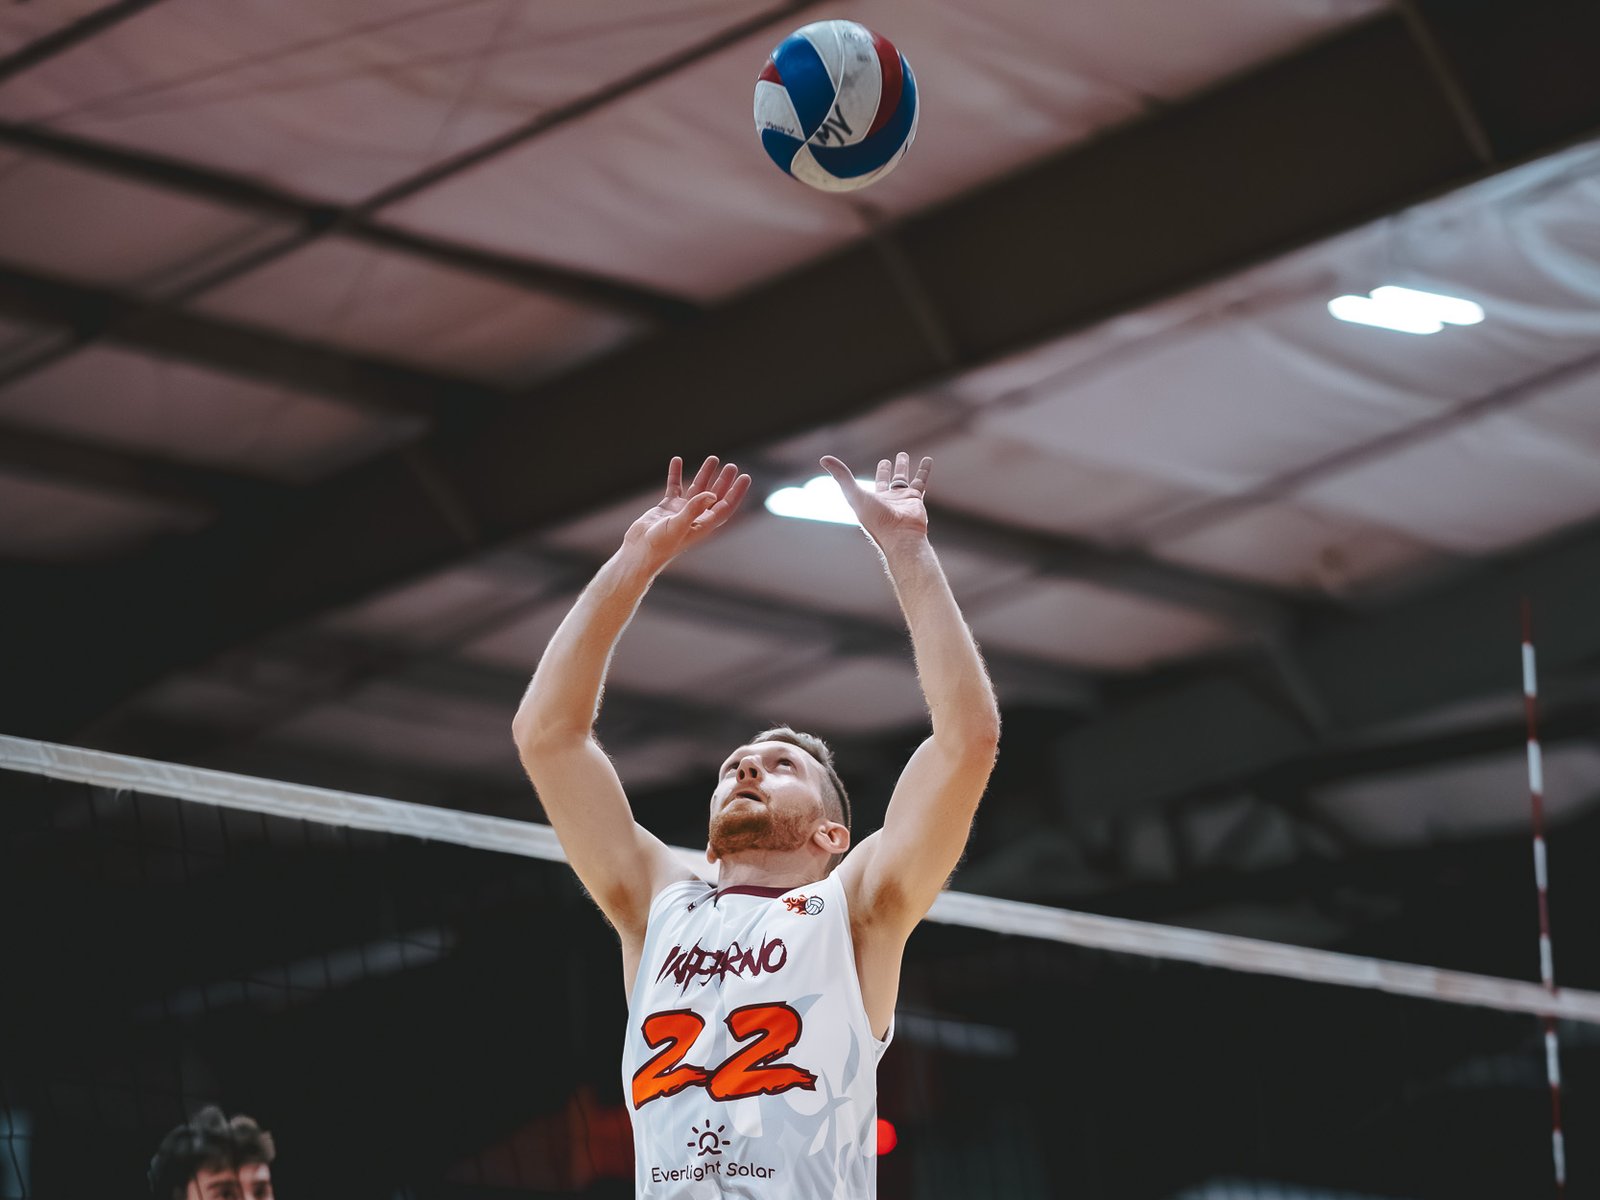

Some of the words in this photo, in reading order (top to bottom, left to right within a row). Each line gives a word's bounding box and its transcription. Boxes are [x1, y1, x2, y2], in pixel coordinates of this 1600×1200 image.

[632, 1002, 818, 1110] 22
[652, 1161, 721, 1183] Everlight
[726, 1162, 776, 1179] Solar
